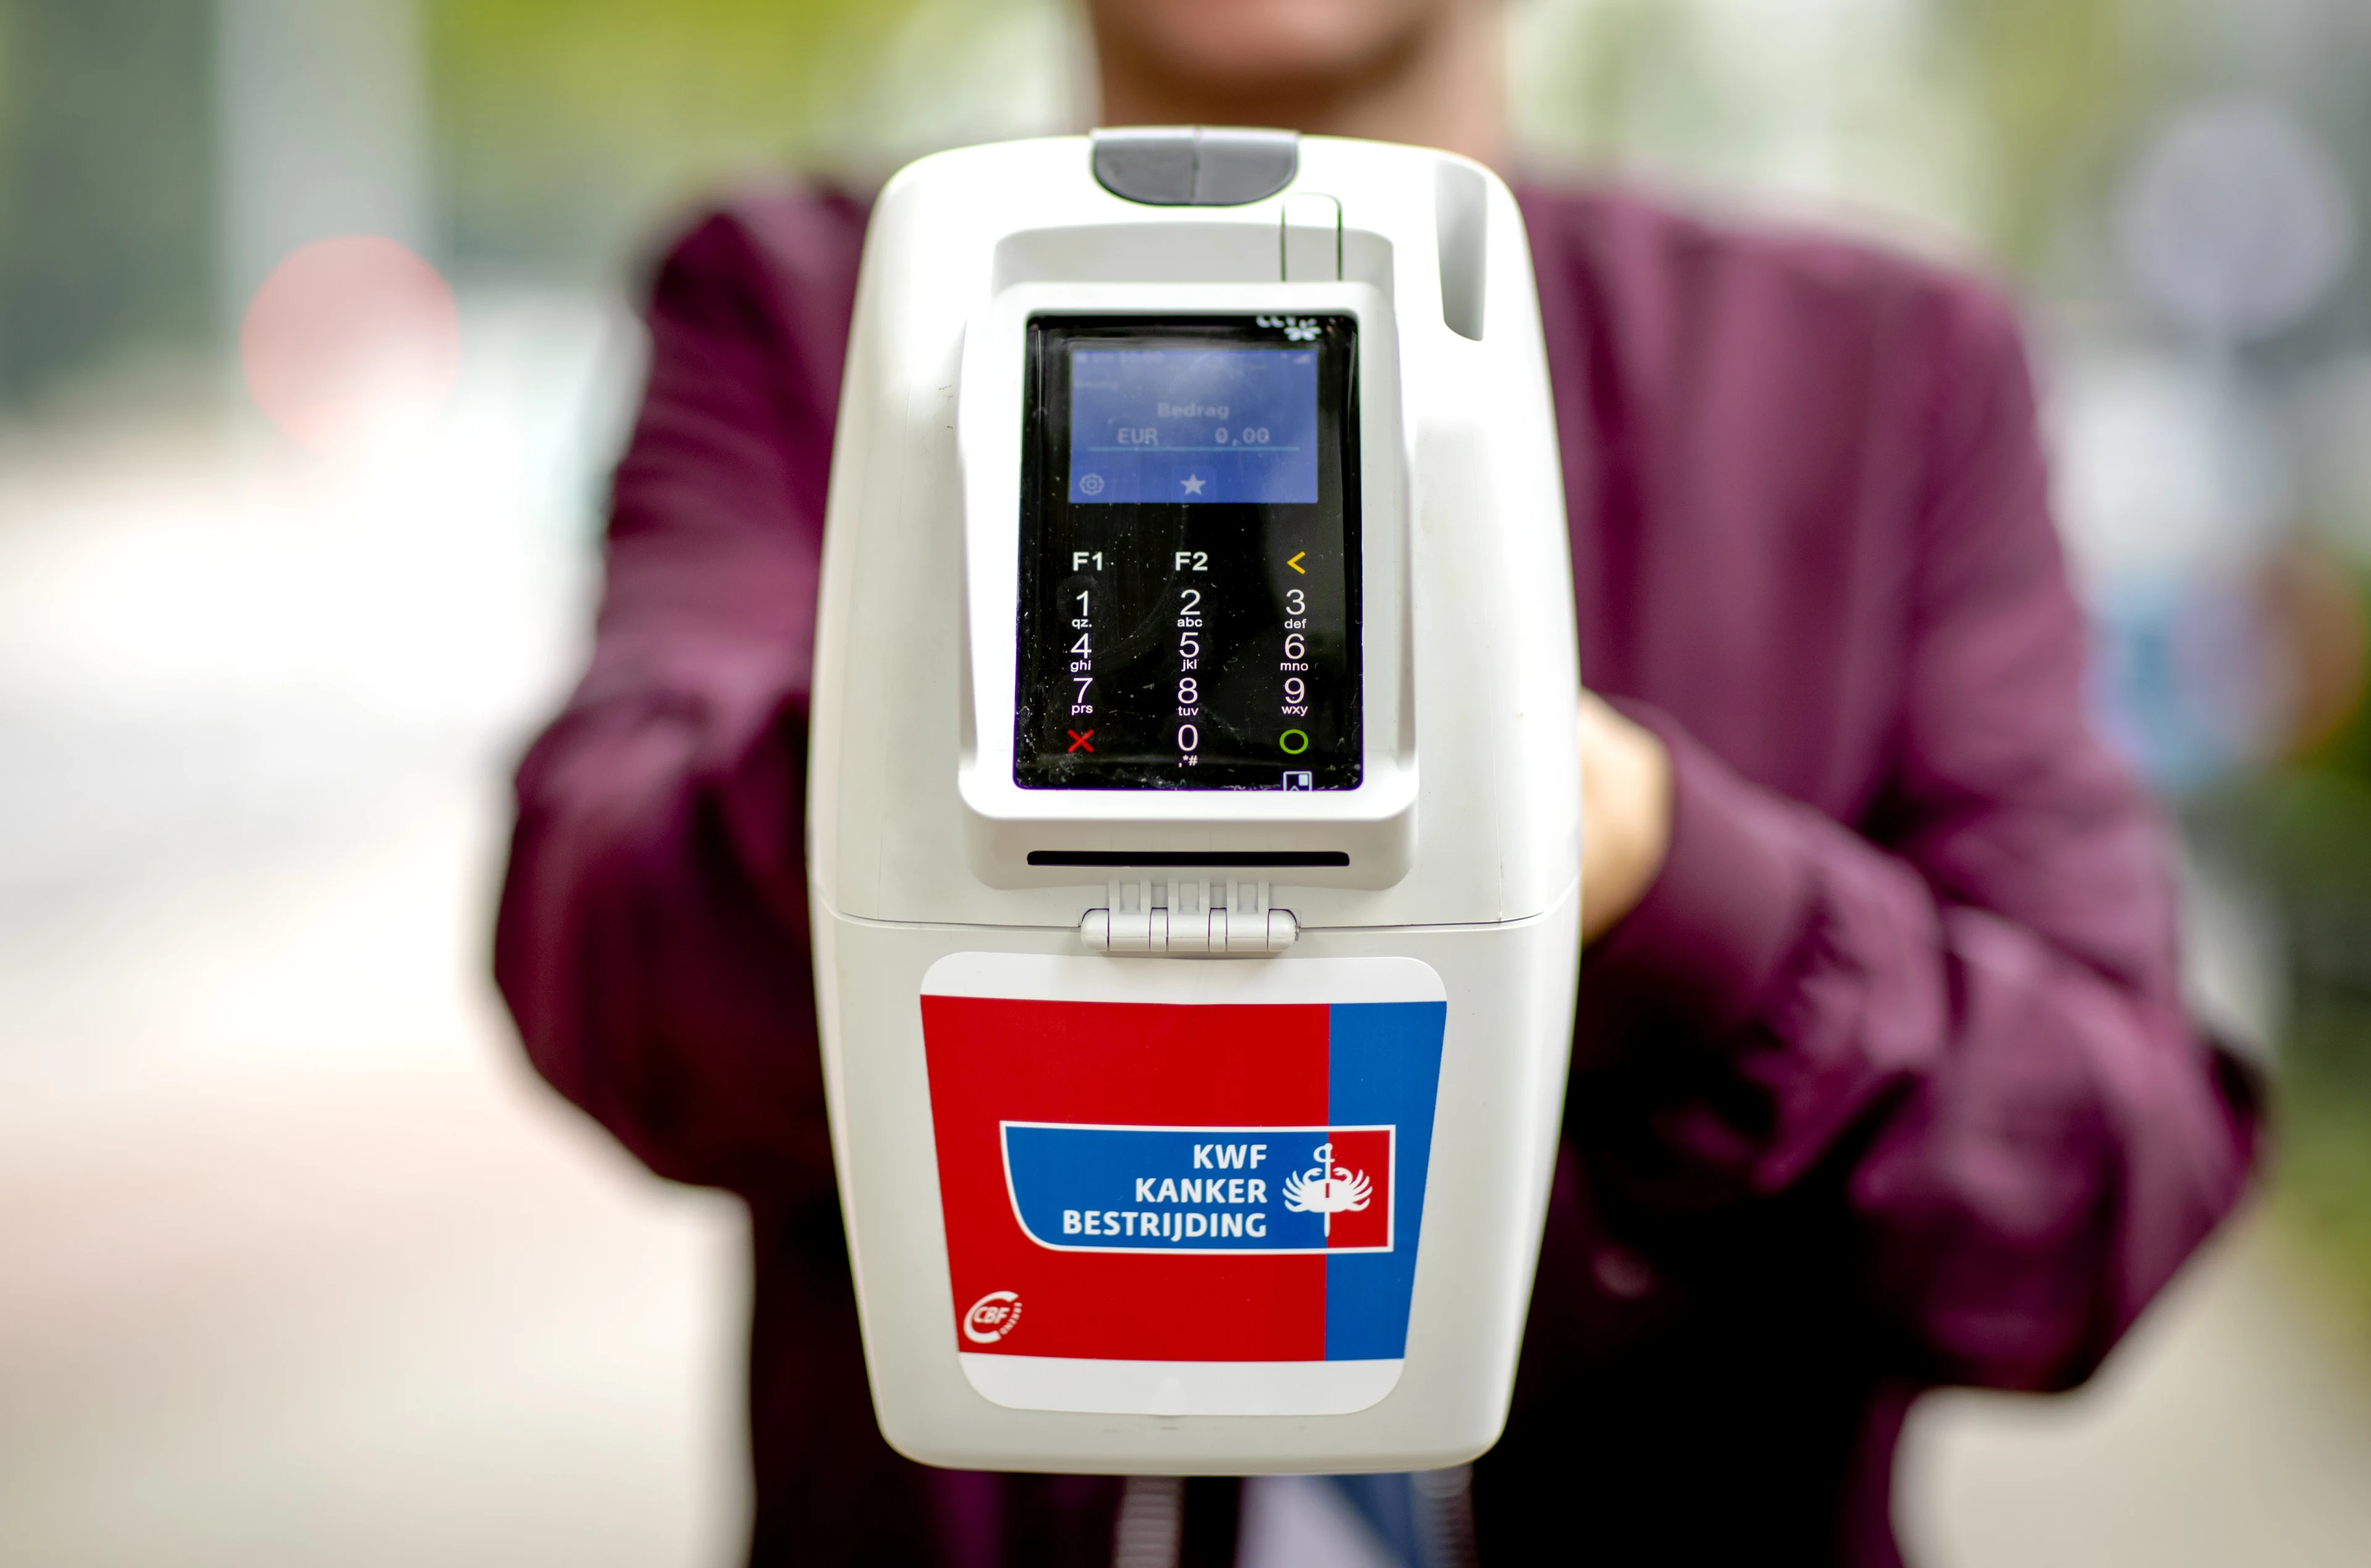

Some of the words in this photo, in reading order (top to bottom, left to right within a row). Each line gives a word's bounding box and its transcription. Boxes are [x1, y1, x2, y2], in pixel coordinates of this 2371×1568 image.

[1156, 402, 1230, 420] Bedrag
[1116, 427, 1158, 446] EUR
[1073, 551, 1103, 572] F1
[1175, 551, 1208, 571] F2
[1076, 590, 1089, 617] 1
[1180, 589, 1201, 615] 2
[1286, 588, 1306, 615] 3
[1071, 619, 1092, 630] qz.
[1177, 617, 1203, 627] abc
[1284, 618, 1307, 629] def
[1070, 633, 1092, 659] 4
[1179, 632, 1200, 658] 5
[1284, 633, 1305, 660] 6
[1070, 659, 1092, 673] ghi
[1181, 659, 1197, 672] jkl
[1280, 662, 1308, 672] mno
[1073, 677, 1094, 704] 7
[1177, 677, 1198, 704] 8
[1284, 677, 1305, 704] 9
[1071, 704, 1094, 716] prs
[1177, 706, 1199, 716] tuv
[1281, 706, 1308, 717] wxy
[1177, 724, 1198, 751] 0
[1193, 1144, 1268, 1170] KWF
[1135, 1177, 1268, 1204] KANKER
[1063, 1209, 1267, 1242] BESTRIJDING
[974, 1306, 1011, 1325] CBF
